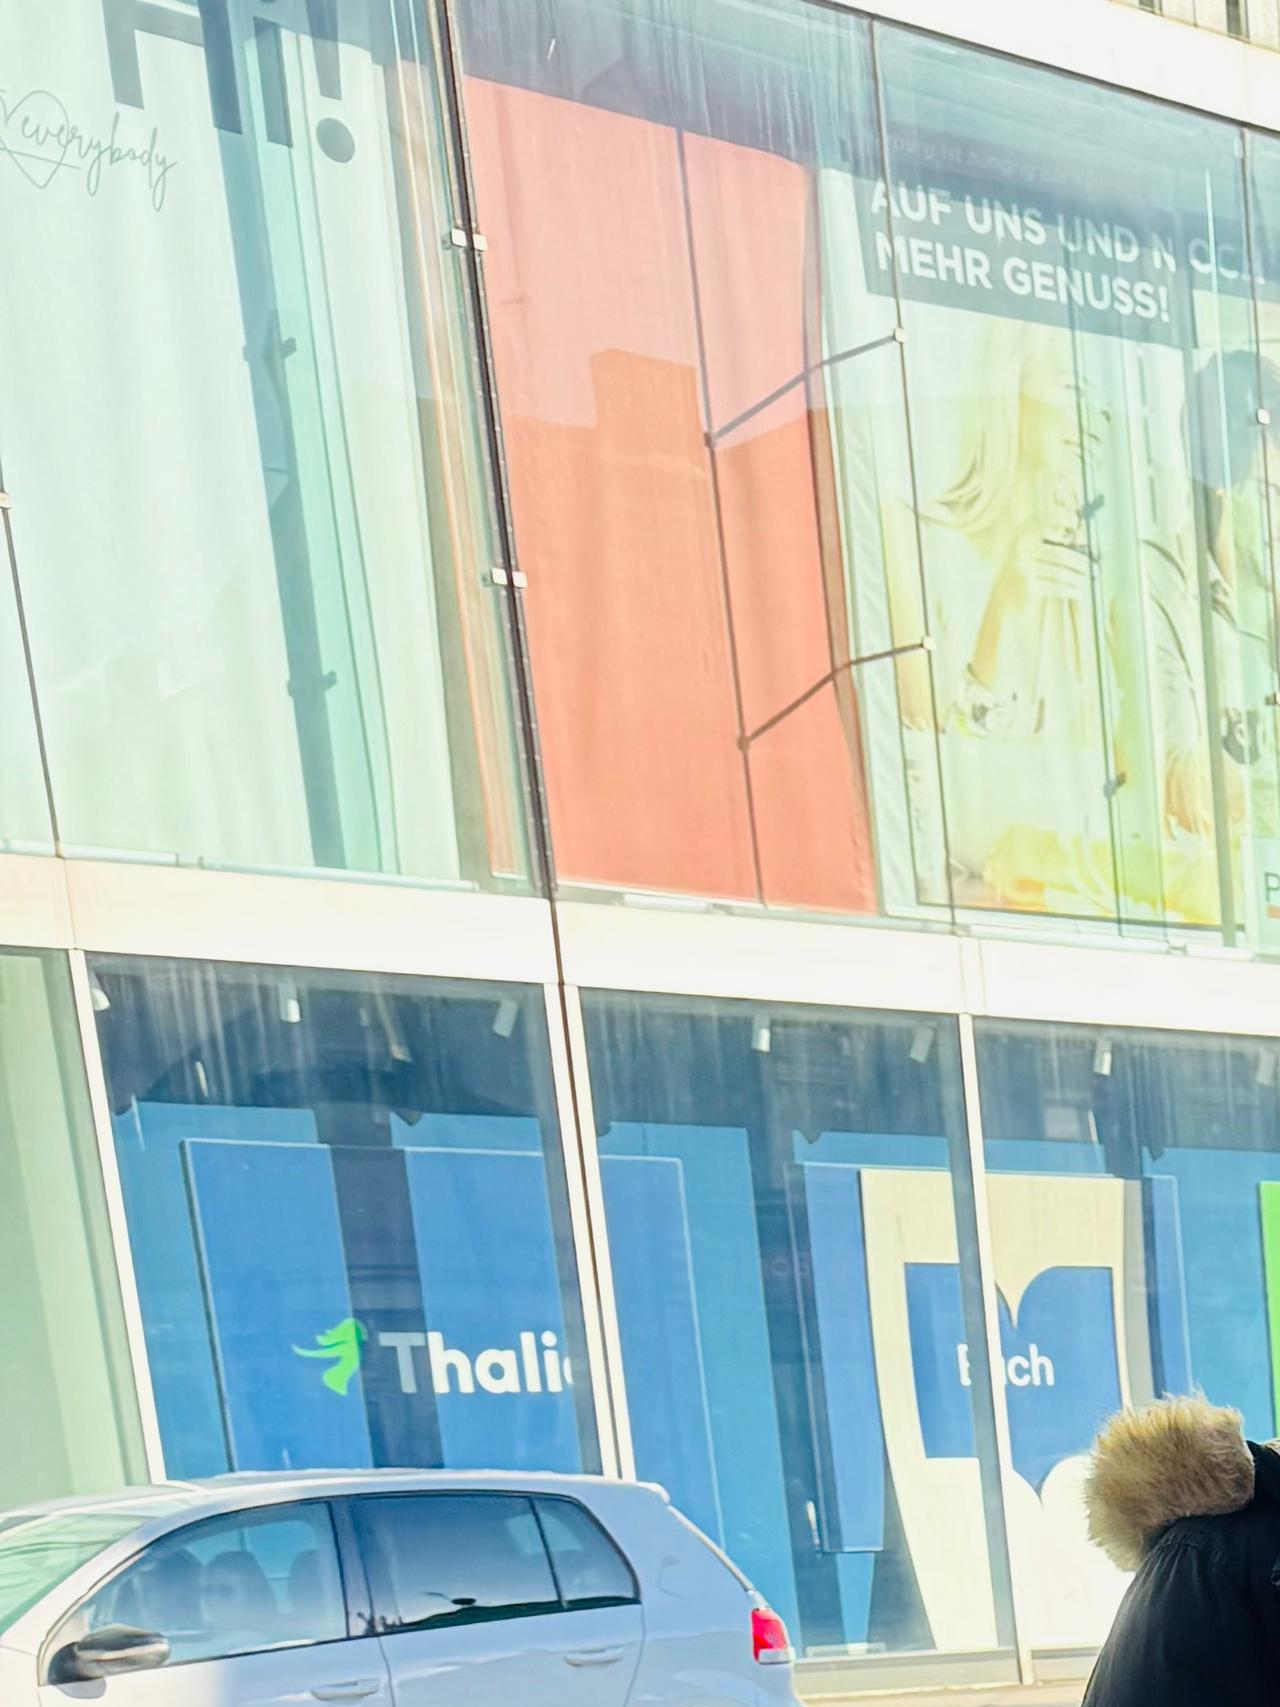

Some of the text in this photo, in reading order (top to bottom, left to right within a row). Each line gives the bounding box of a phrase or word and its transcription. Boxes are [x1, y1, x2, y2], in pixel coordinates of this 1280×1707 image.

[872, 177, 952, 226] AUF
[965, 194, 1046, 245] UNS
[1058, 213, 1140, 265] UND
[875, 231, 1170, 323] MEHR GENUSS!
[956, 1343, 1056, 1387] ch
